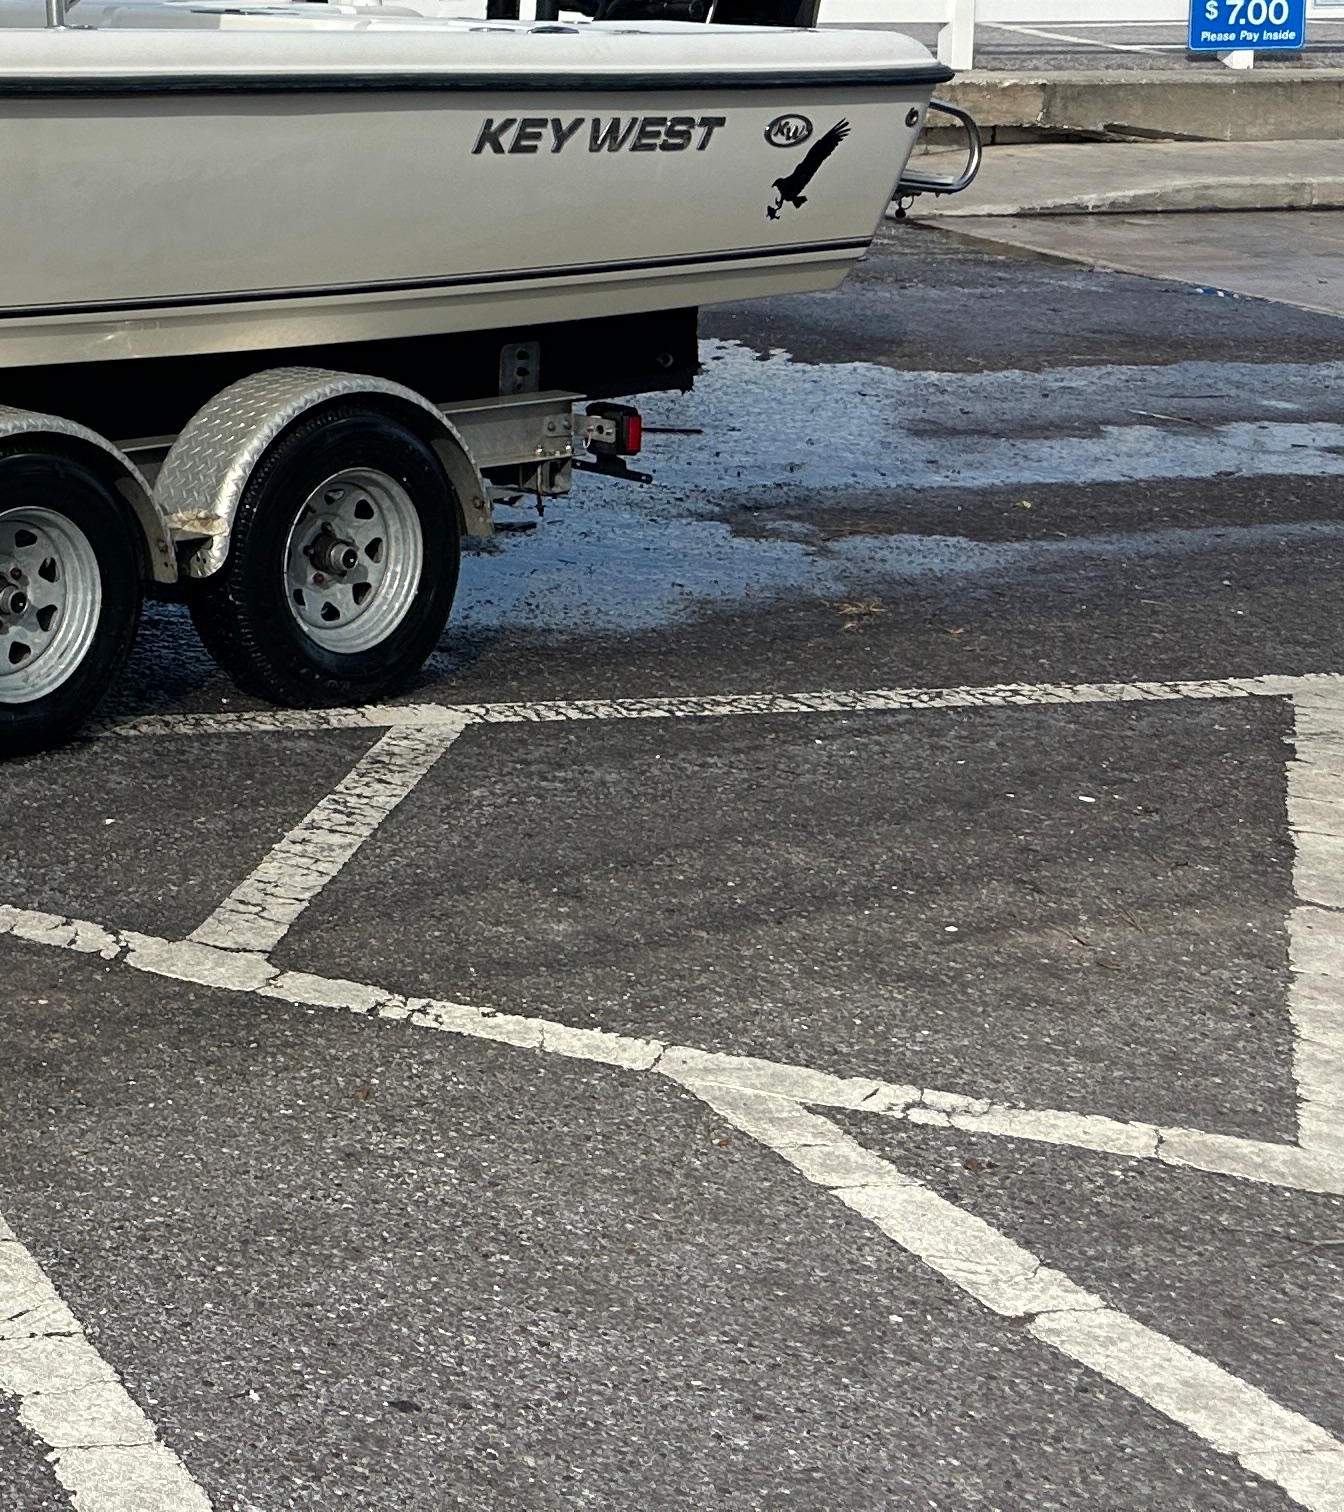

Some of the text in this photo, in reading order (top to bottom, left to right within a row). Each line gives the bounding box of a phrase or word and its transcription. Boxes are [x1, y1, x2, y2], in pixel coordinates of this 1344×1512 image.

[1205, 0, 1219, 20] $
[1200, 29, 1297, 42] Please Pay Inside
[471, 117, 727, 154] KEY WEST
